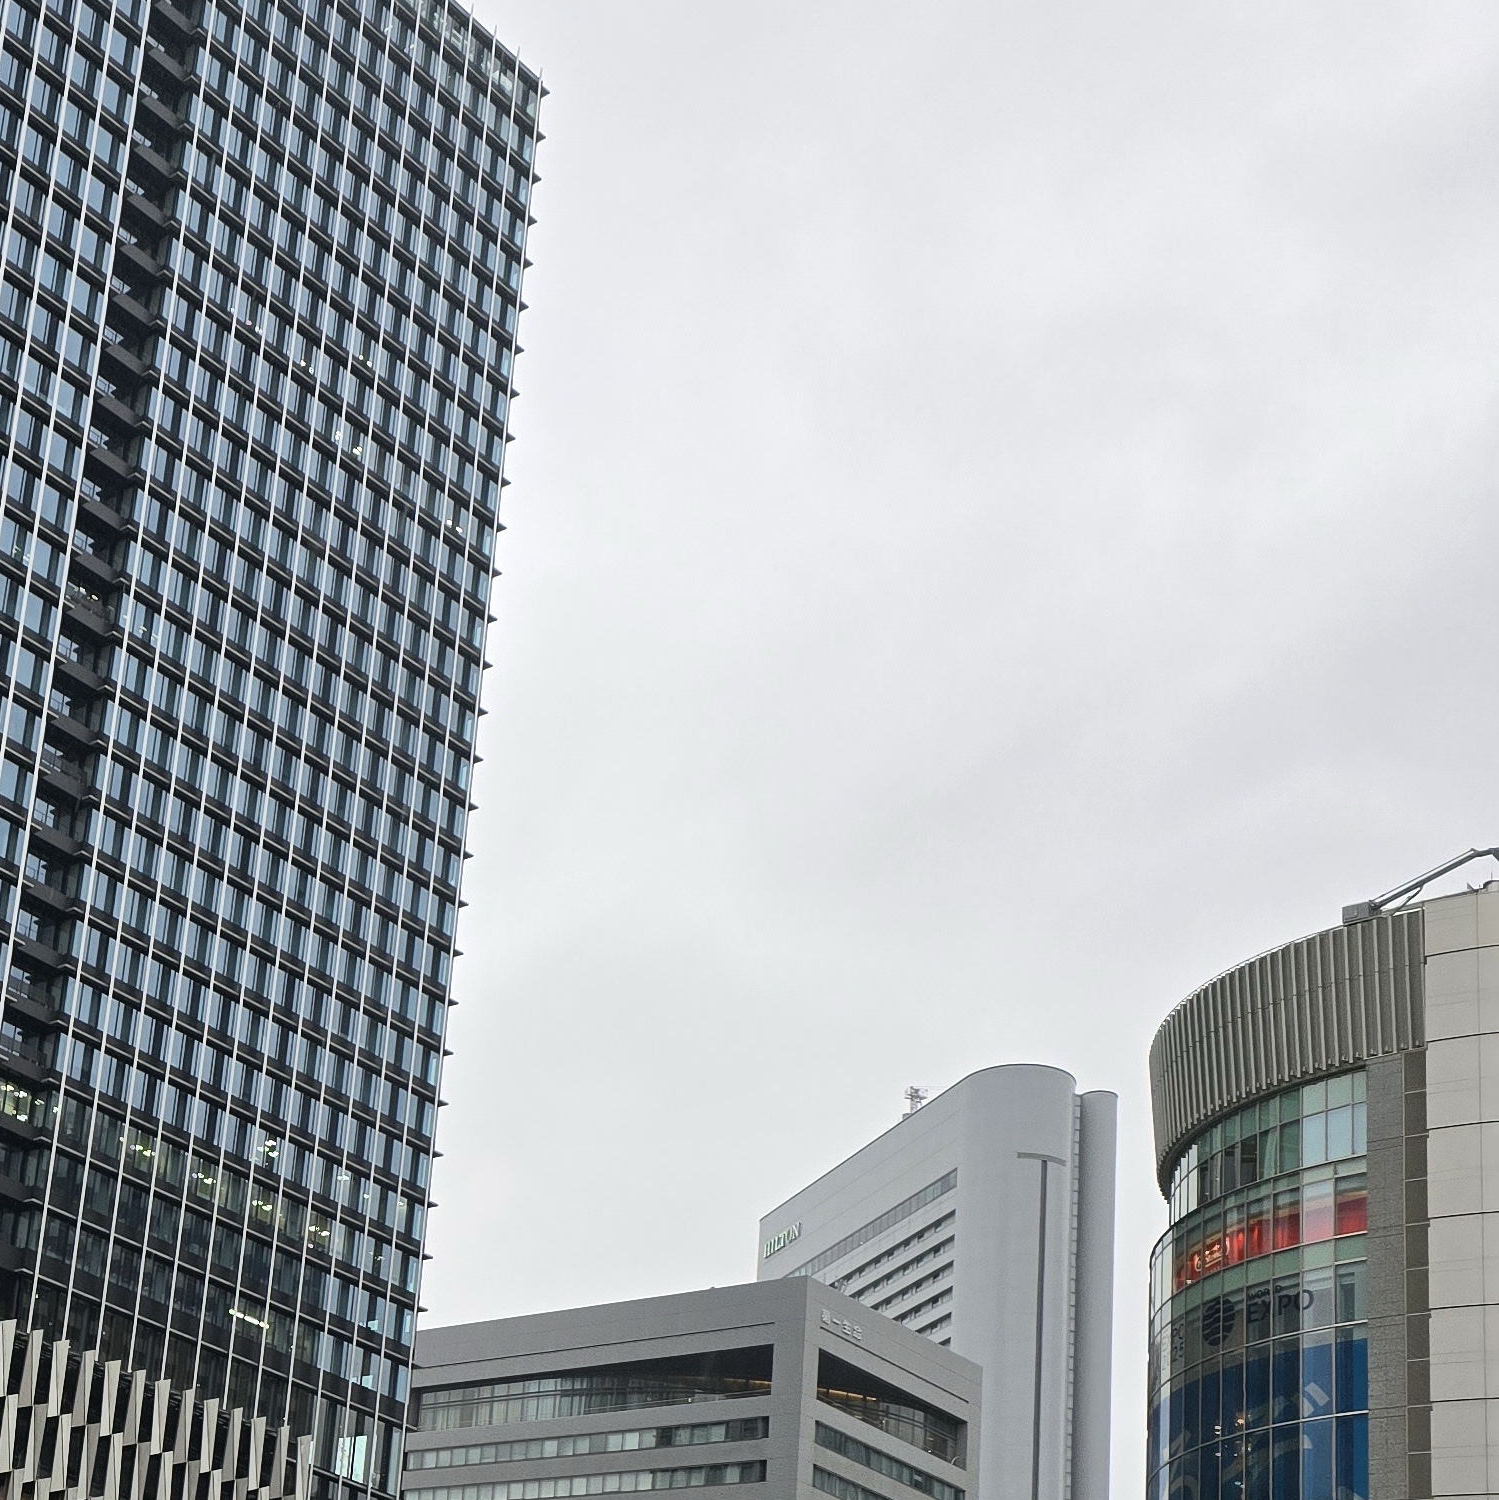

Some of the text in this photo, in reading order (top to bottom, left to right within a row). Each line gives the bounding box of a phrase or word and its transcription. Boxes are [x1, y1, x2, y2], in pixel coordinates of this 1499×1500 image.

[764, 1222, 800, 1258] HILTON
[1247, 1286, 1282, 1300] WORD
[1248, 1290, 1314, 1322] EXPO
